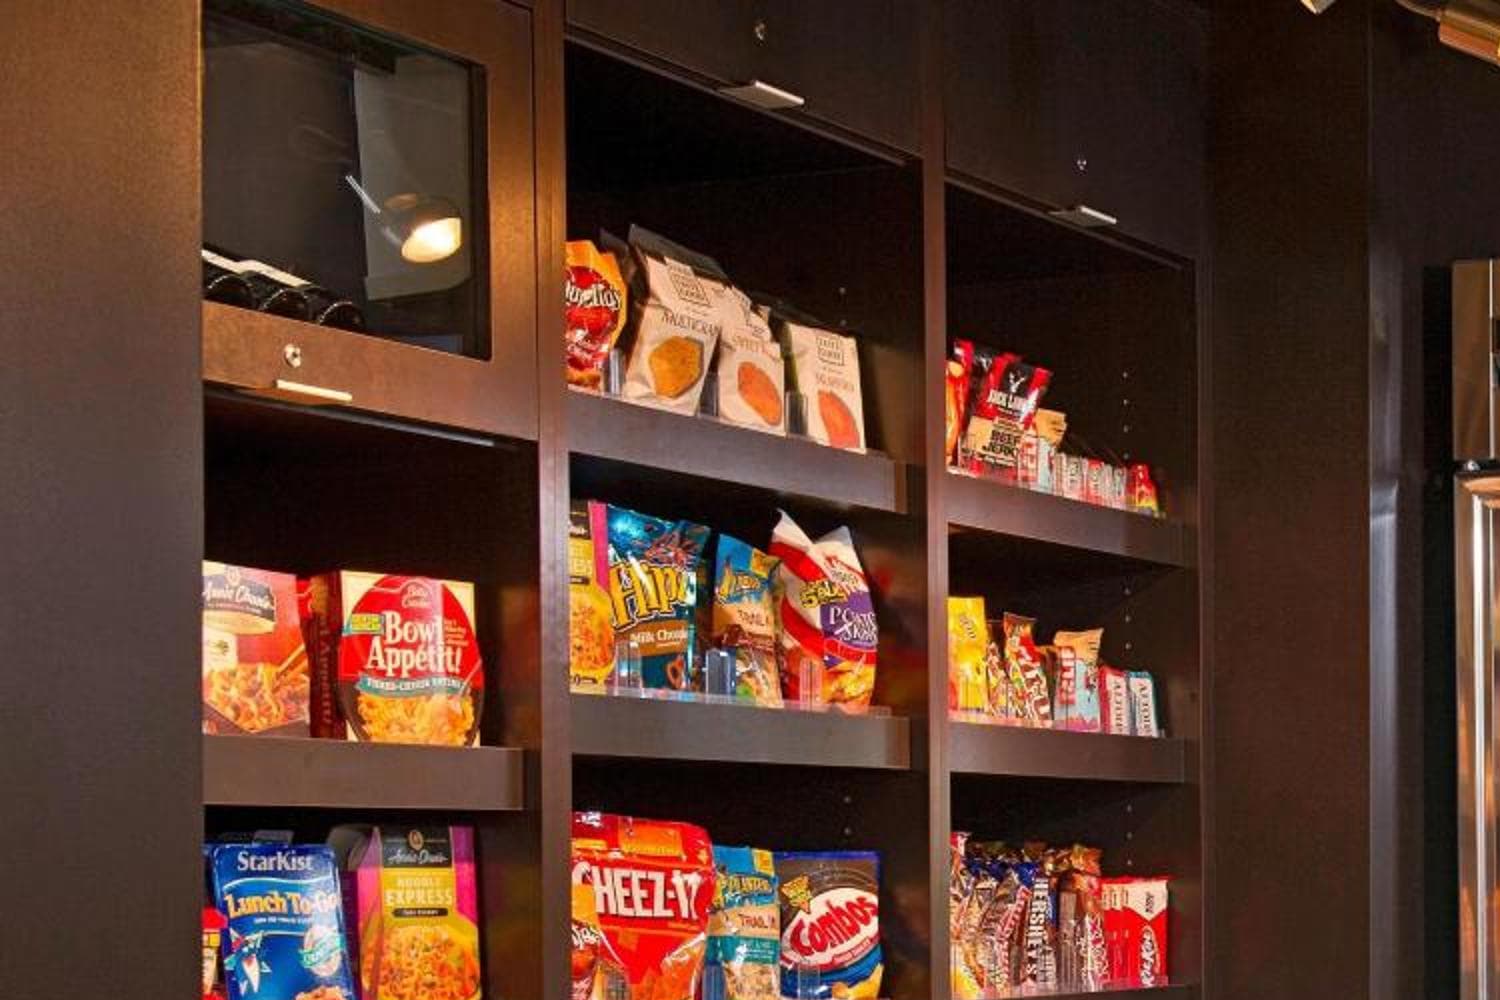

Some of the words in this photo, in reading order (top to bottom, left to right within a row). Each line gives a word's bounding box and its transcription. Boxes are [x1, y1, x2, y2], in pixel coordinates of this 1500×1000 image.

[381, 610, 444, 645] Bowl
[236, 850, 314, 872] StarKist
[223, 891, 288, 918] Lunch
[384, 887, 453, 907] EXPRESS
[789, 895, 878, 957] Combos
[1028, 876, 1050, 981] HERSHEY'S
